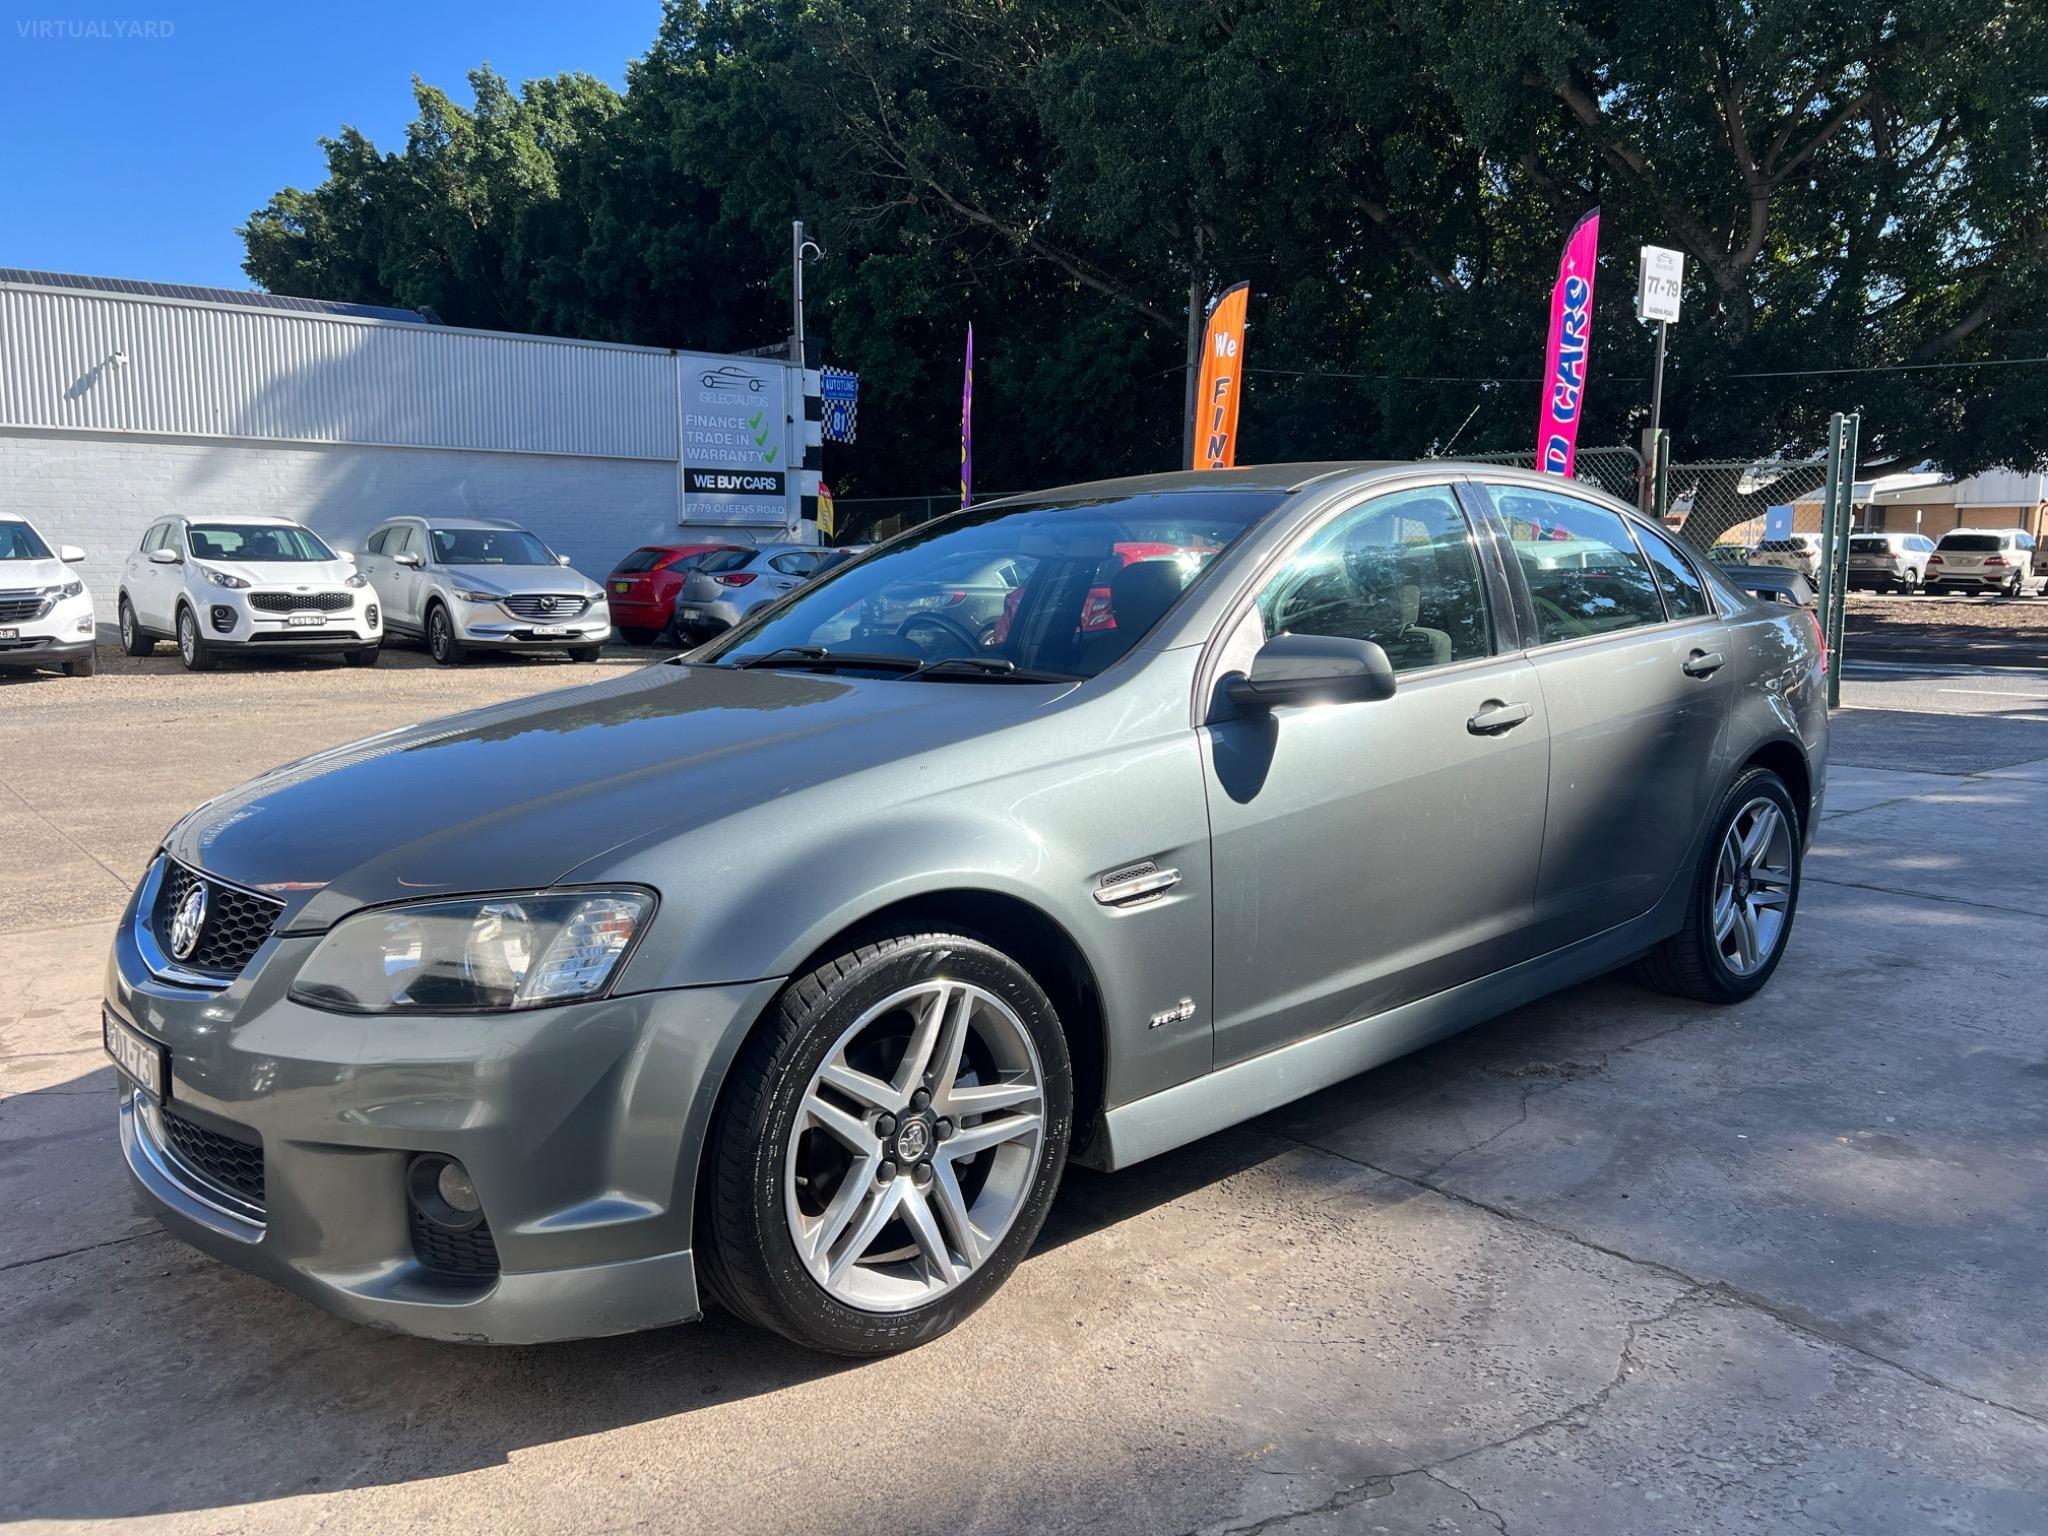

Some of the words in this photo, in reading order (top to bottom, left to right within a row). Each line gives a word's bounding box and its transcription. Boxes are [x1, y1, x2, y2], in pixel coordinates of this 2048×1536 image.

[1648, 276, 1679, 297] 77-79
[1214, 331, 1237, 358] We
[1552, 275, 1591, 424] CARS
[825, 379, 855, 392] AUTOTUNE
[685, 414, 746, 430] FINANCE
[833, 411, 846, 433] 81
[686, 431, 733, 445] TRADE
[736, 433, 750, 446] IN
[686, 447, 765, 462] WARRANTY
[693, 474, 716, 489] WE
[717, 475, 743, 490] BUY
[743, 476, 777, 491] CARS
[686, 503, 712, 514] 77-79
[714, 503, 755, 515] QUEENS
[757, 505, 785, 515] ROAD
